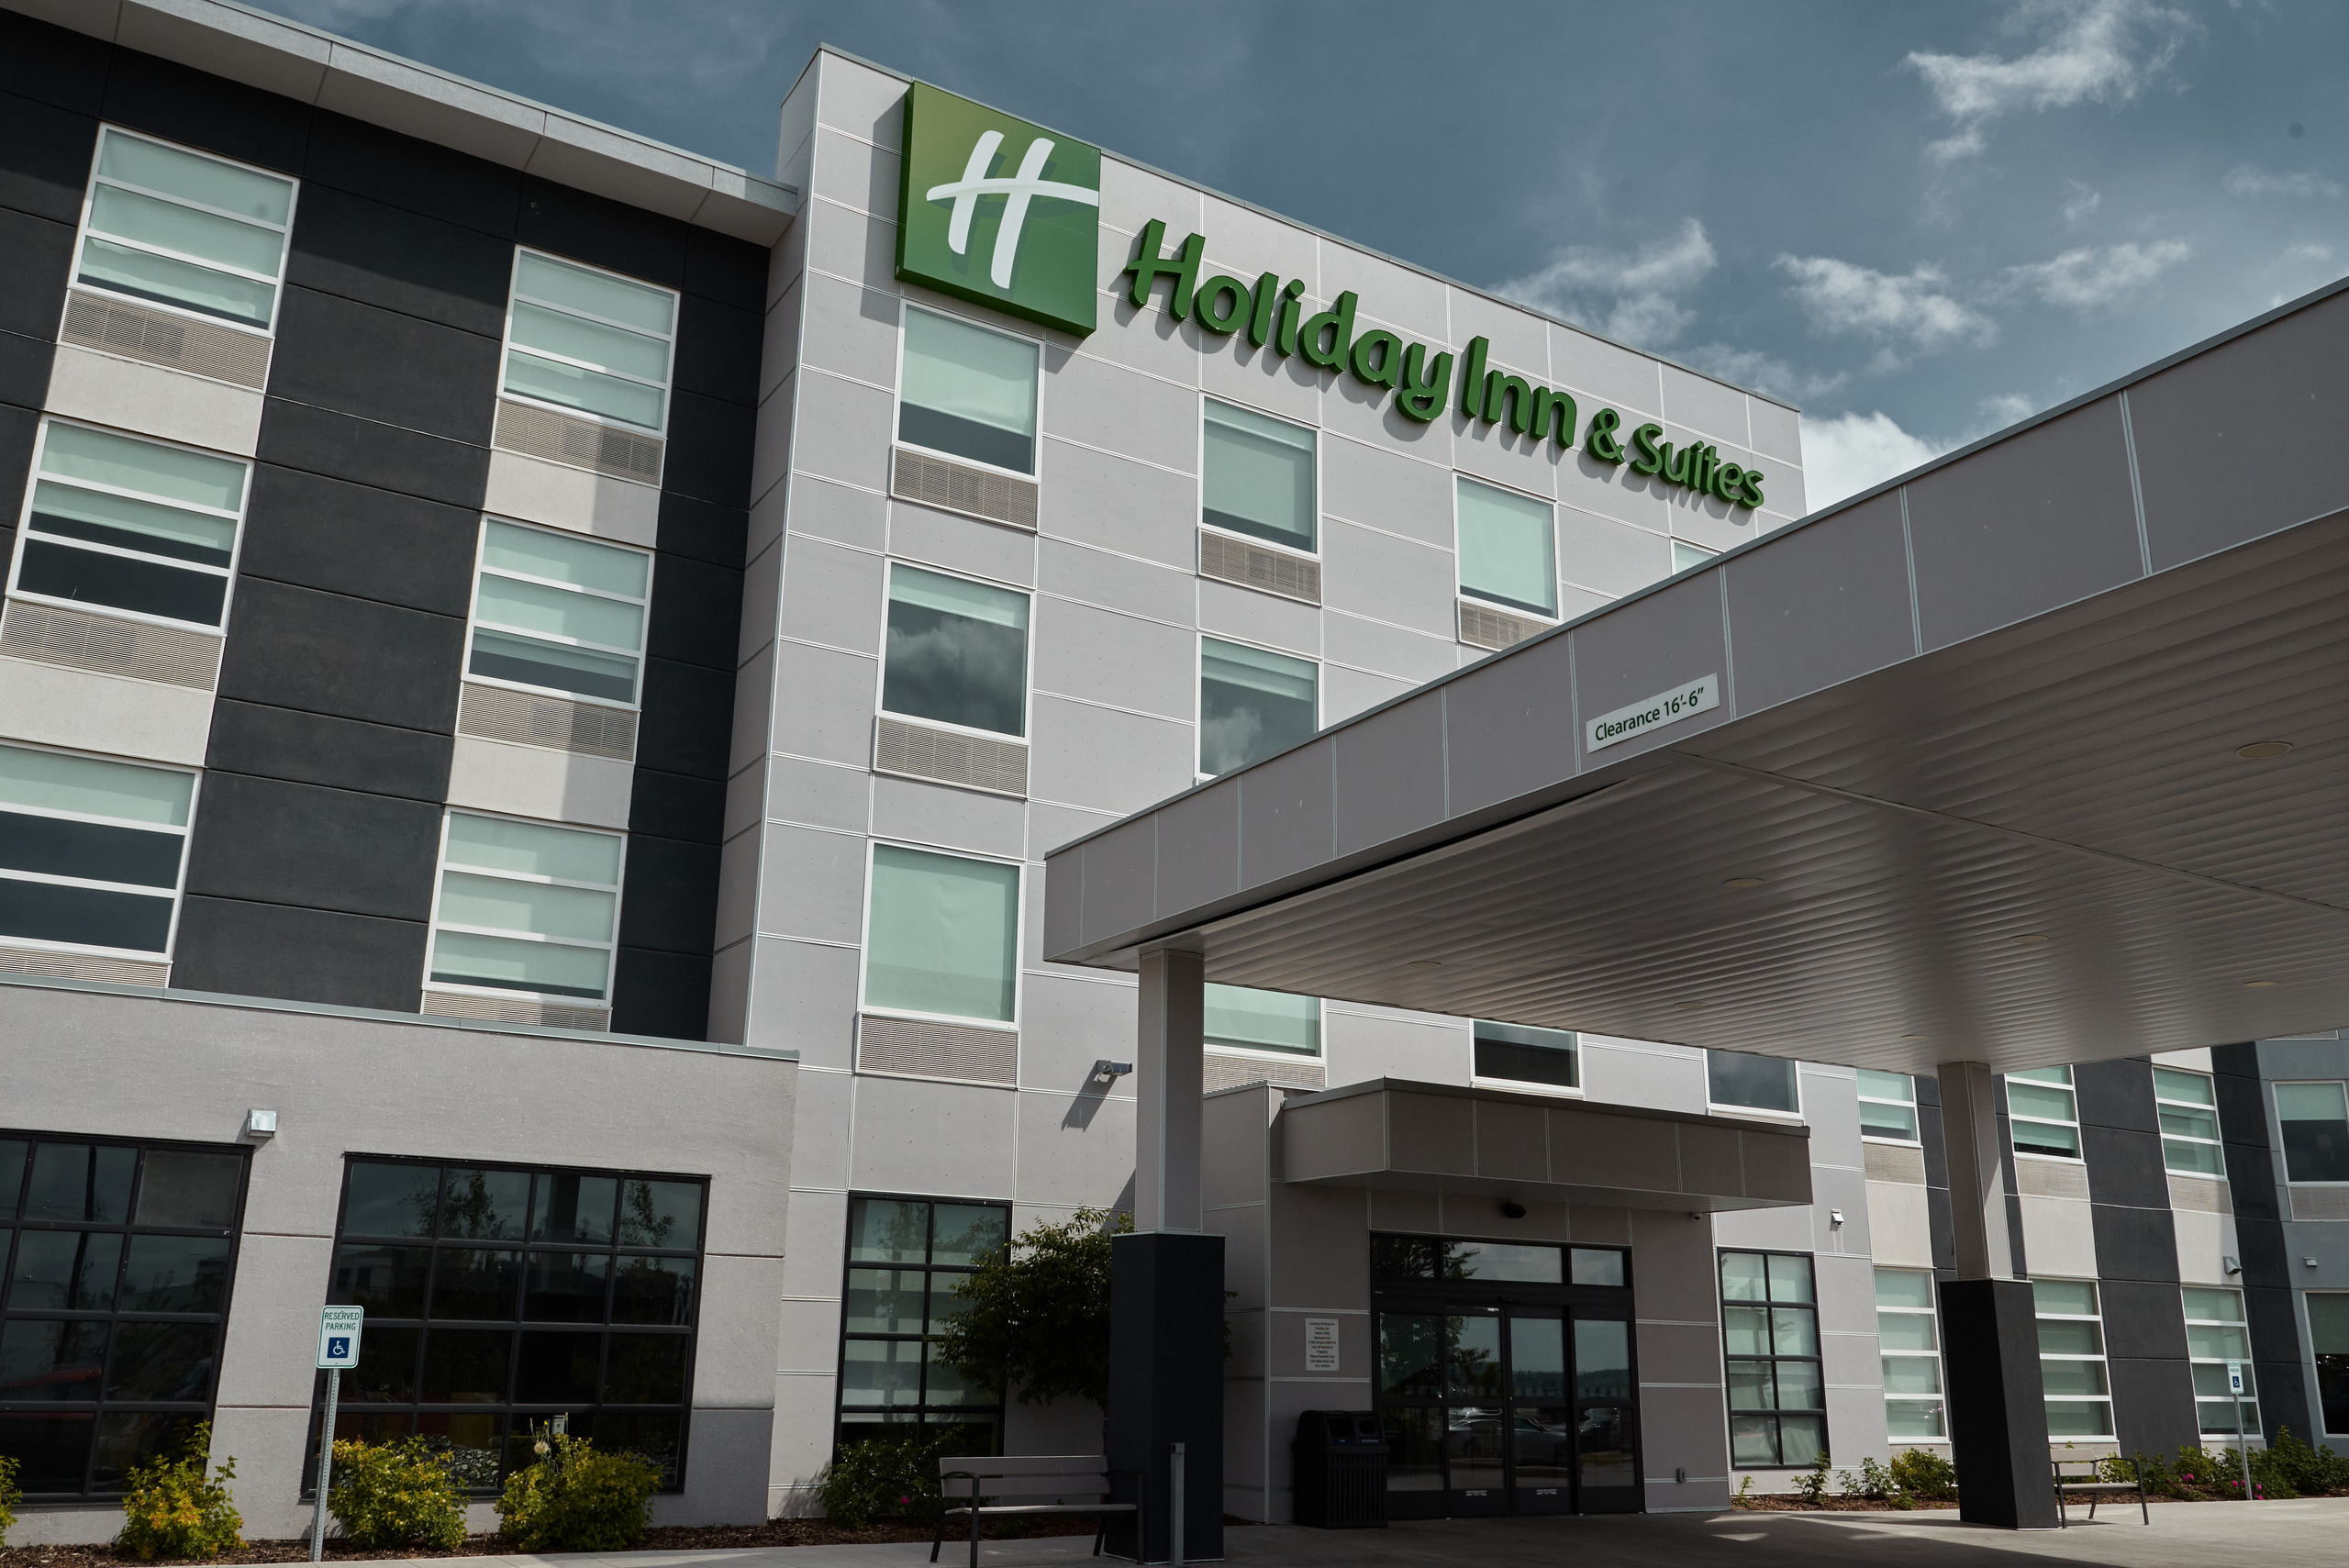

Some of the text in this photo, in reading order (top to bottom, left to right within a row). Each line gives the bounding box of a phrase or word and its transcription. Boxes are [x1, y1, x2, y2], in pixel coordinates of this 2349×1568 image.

[1122, 217, 1765, 510] Holiday Inn & Suites
[1595, 707, 1661, 741] Clearance
[324, 1311, 360, 1320] RESERVED
[325, 1322, 356, 1330] PARKING
